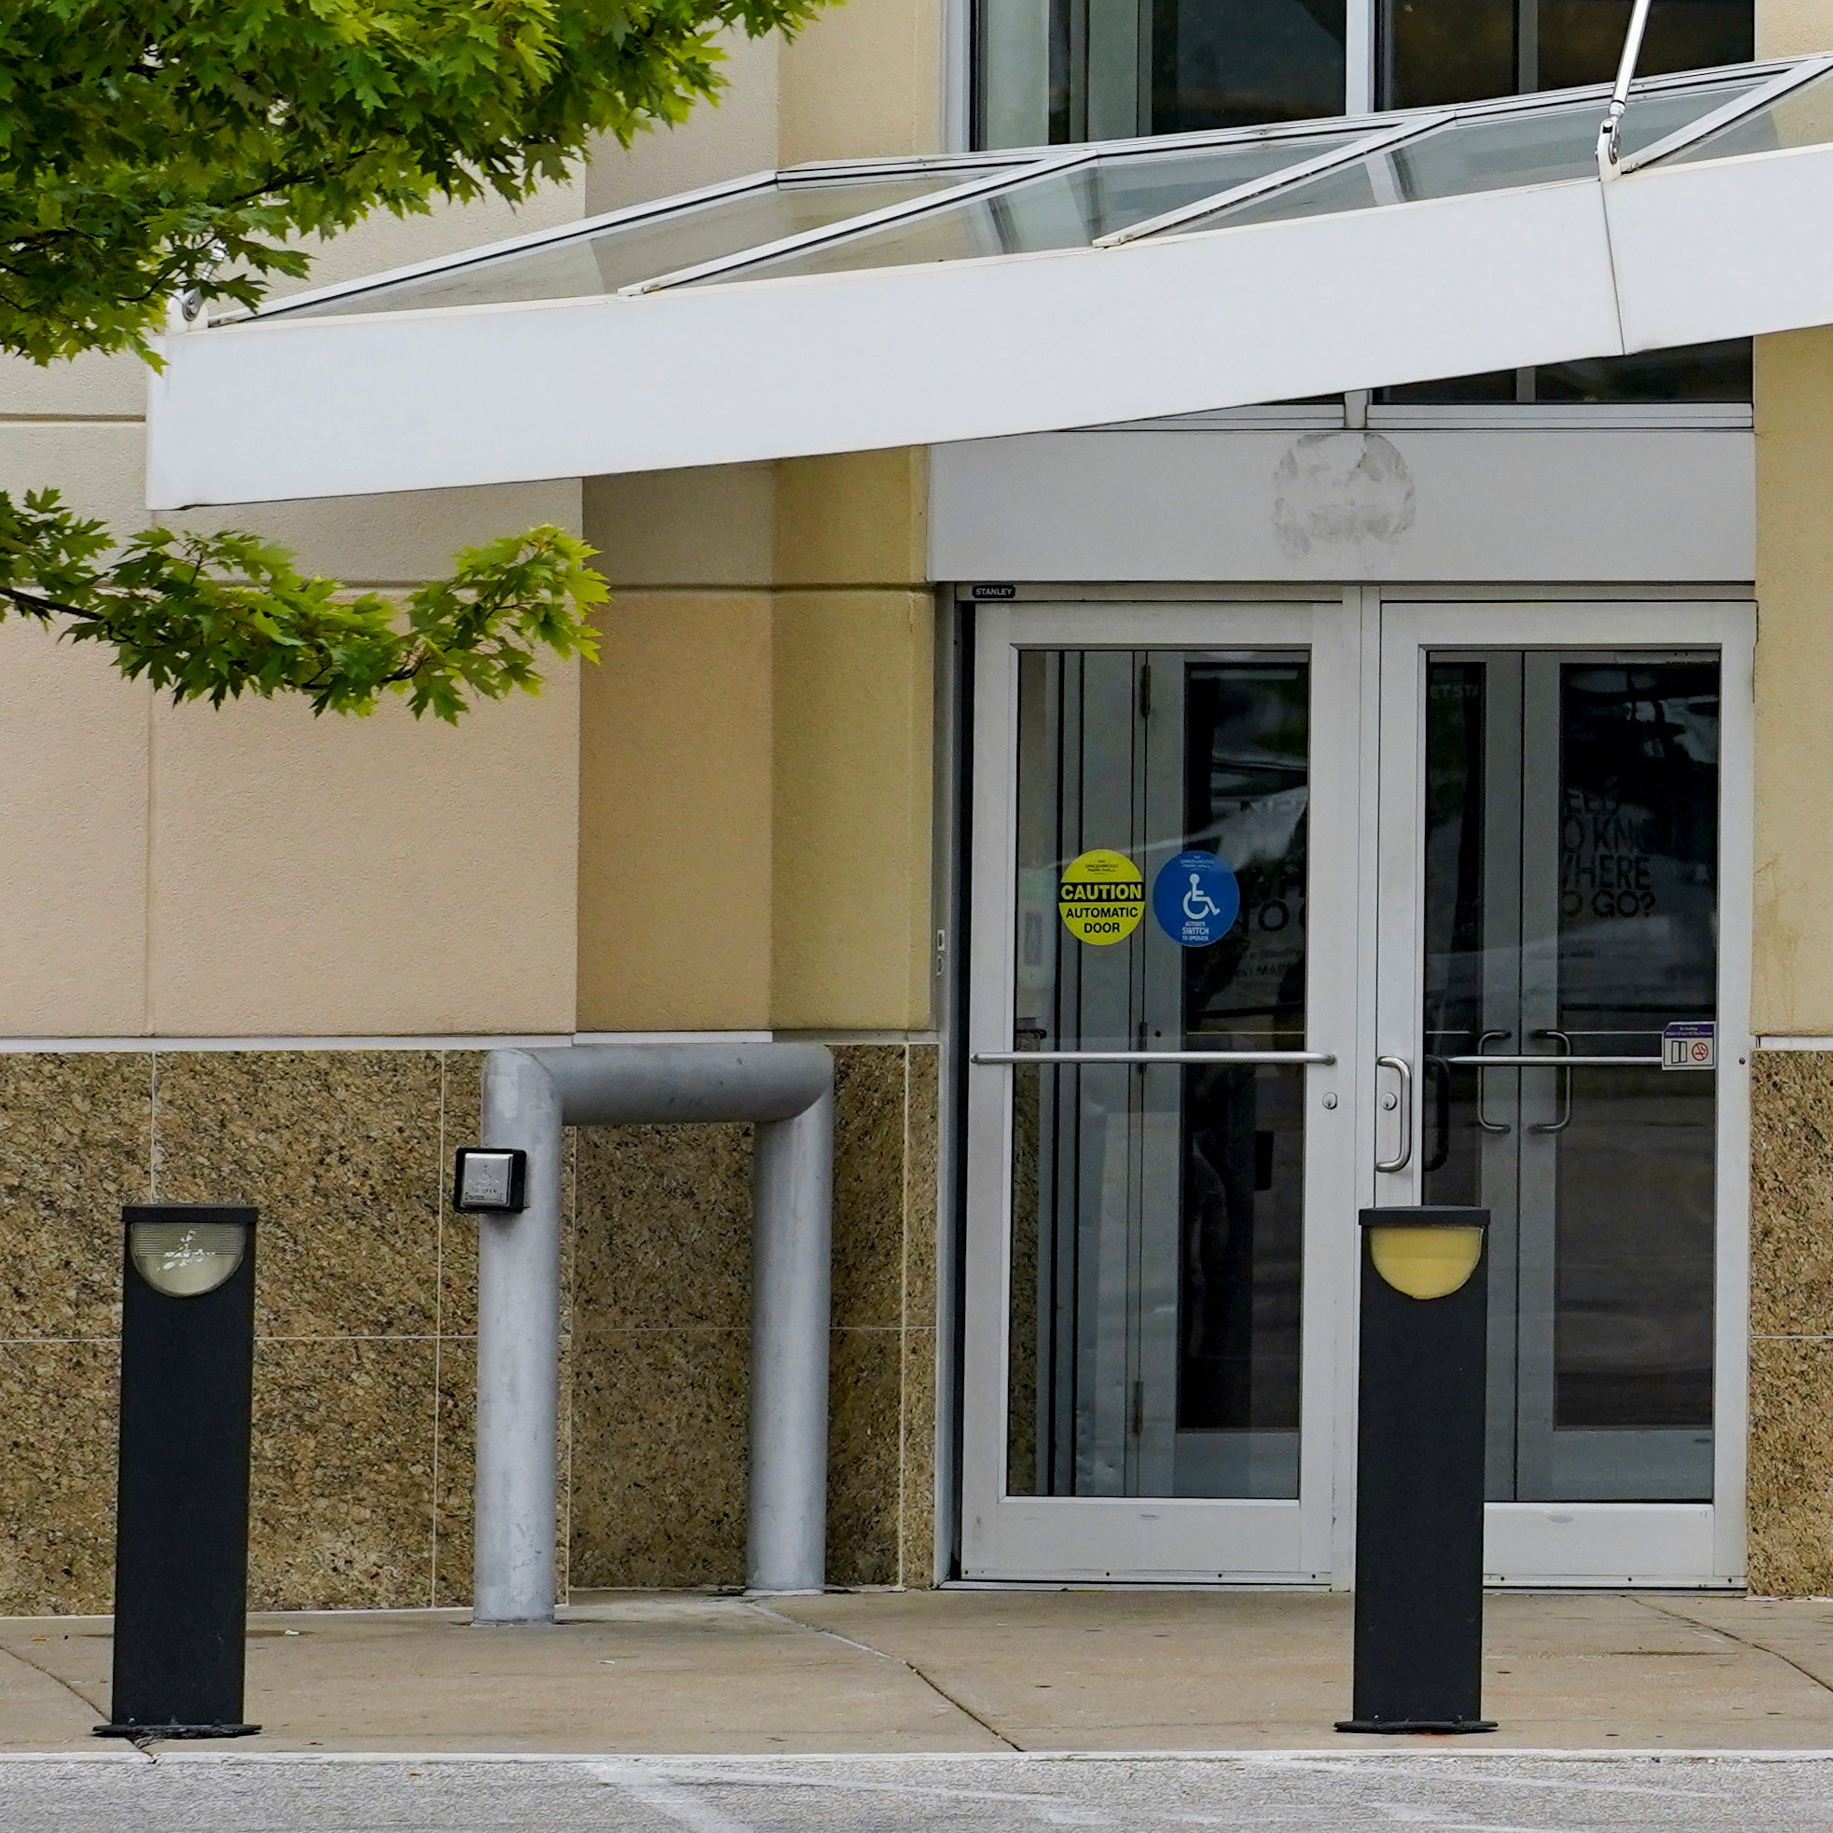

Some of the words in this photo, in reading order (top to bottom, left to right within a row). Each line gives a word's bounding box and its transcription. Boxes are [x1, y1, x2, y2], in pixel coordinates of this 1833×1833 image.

[976, 587, 1013, 596] STANLEY
[1061, 884, 1142, 900] CAUTION
[1066, 907, 1139, 919] AUTOMATIC
[1084, 922, 1121, 934] DOOR
